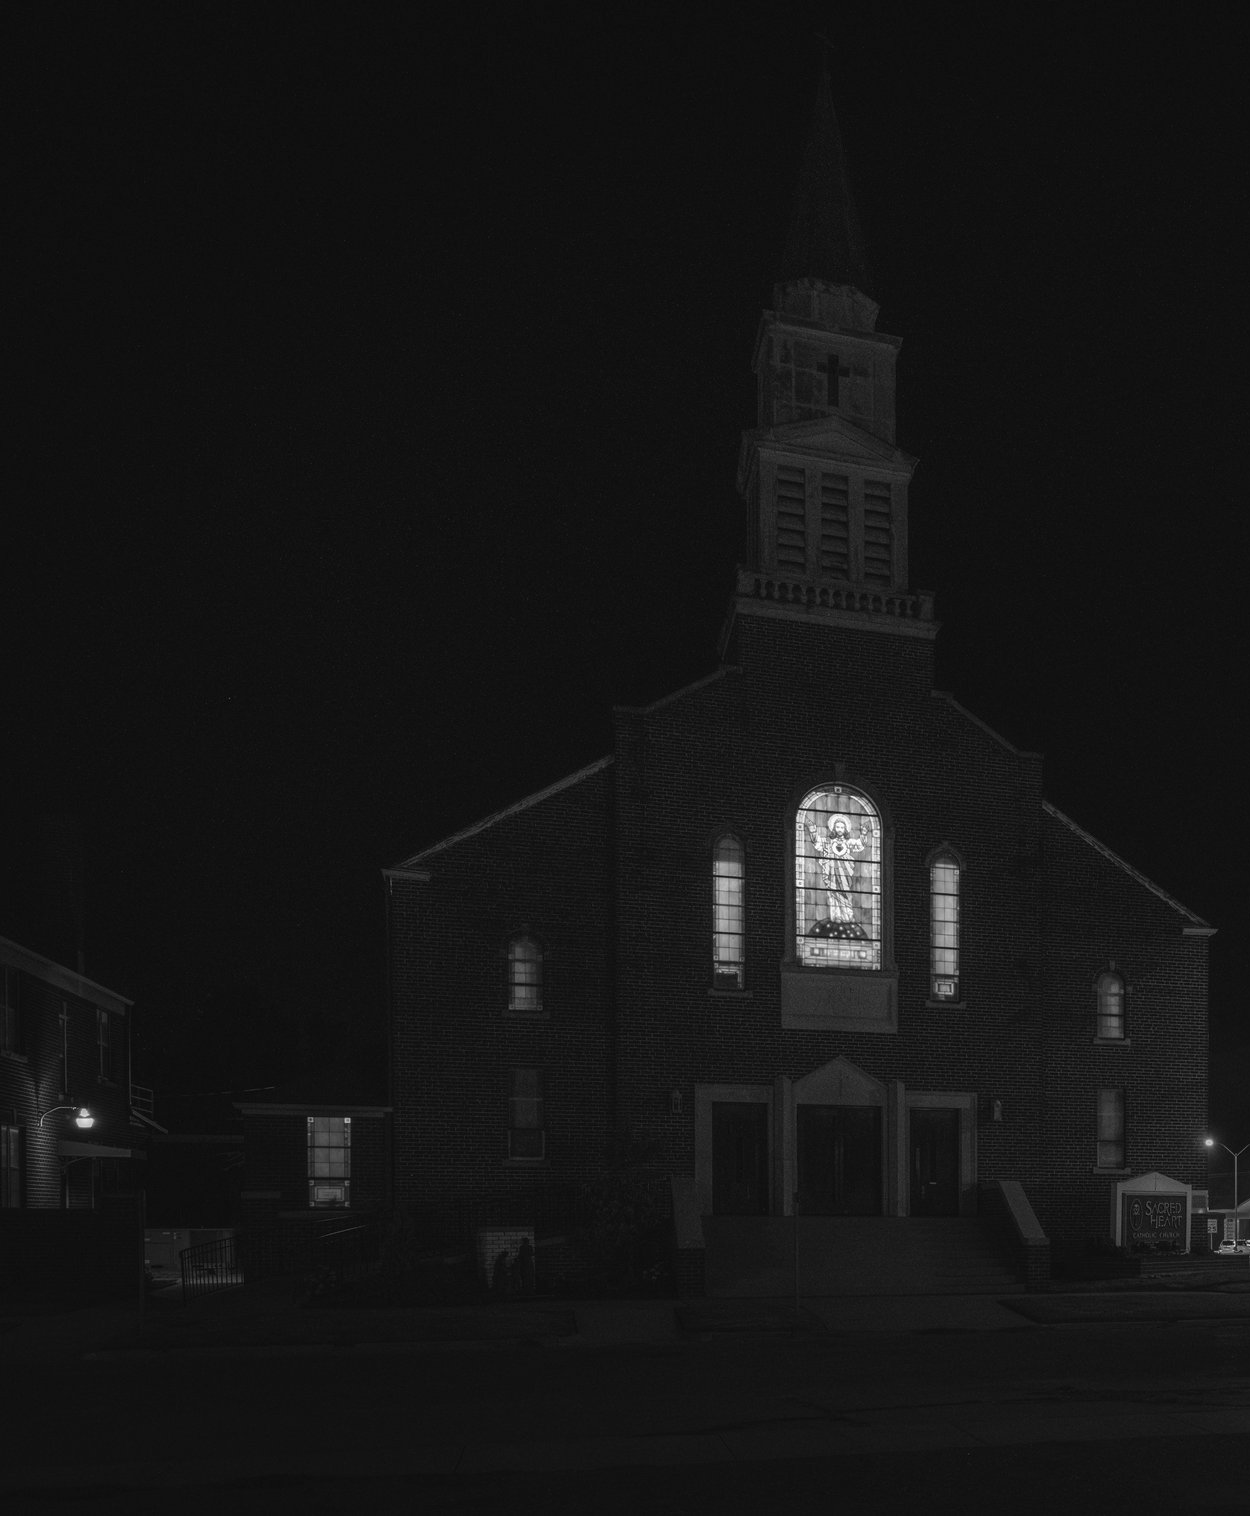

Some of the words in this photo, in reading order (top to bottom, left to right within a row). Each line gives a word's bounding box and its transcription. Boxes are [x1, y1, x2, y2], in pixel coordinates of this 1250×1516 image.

[1145, 1200, 1181, 1217] SACRED
[1150, 1214, 1183, 1229] HEART
[1132, 1231, 1157, 1239] CATHOLIC
[1159, 1231, 1181, 1239] CHURCH
